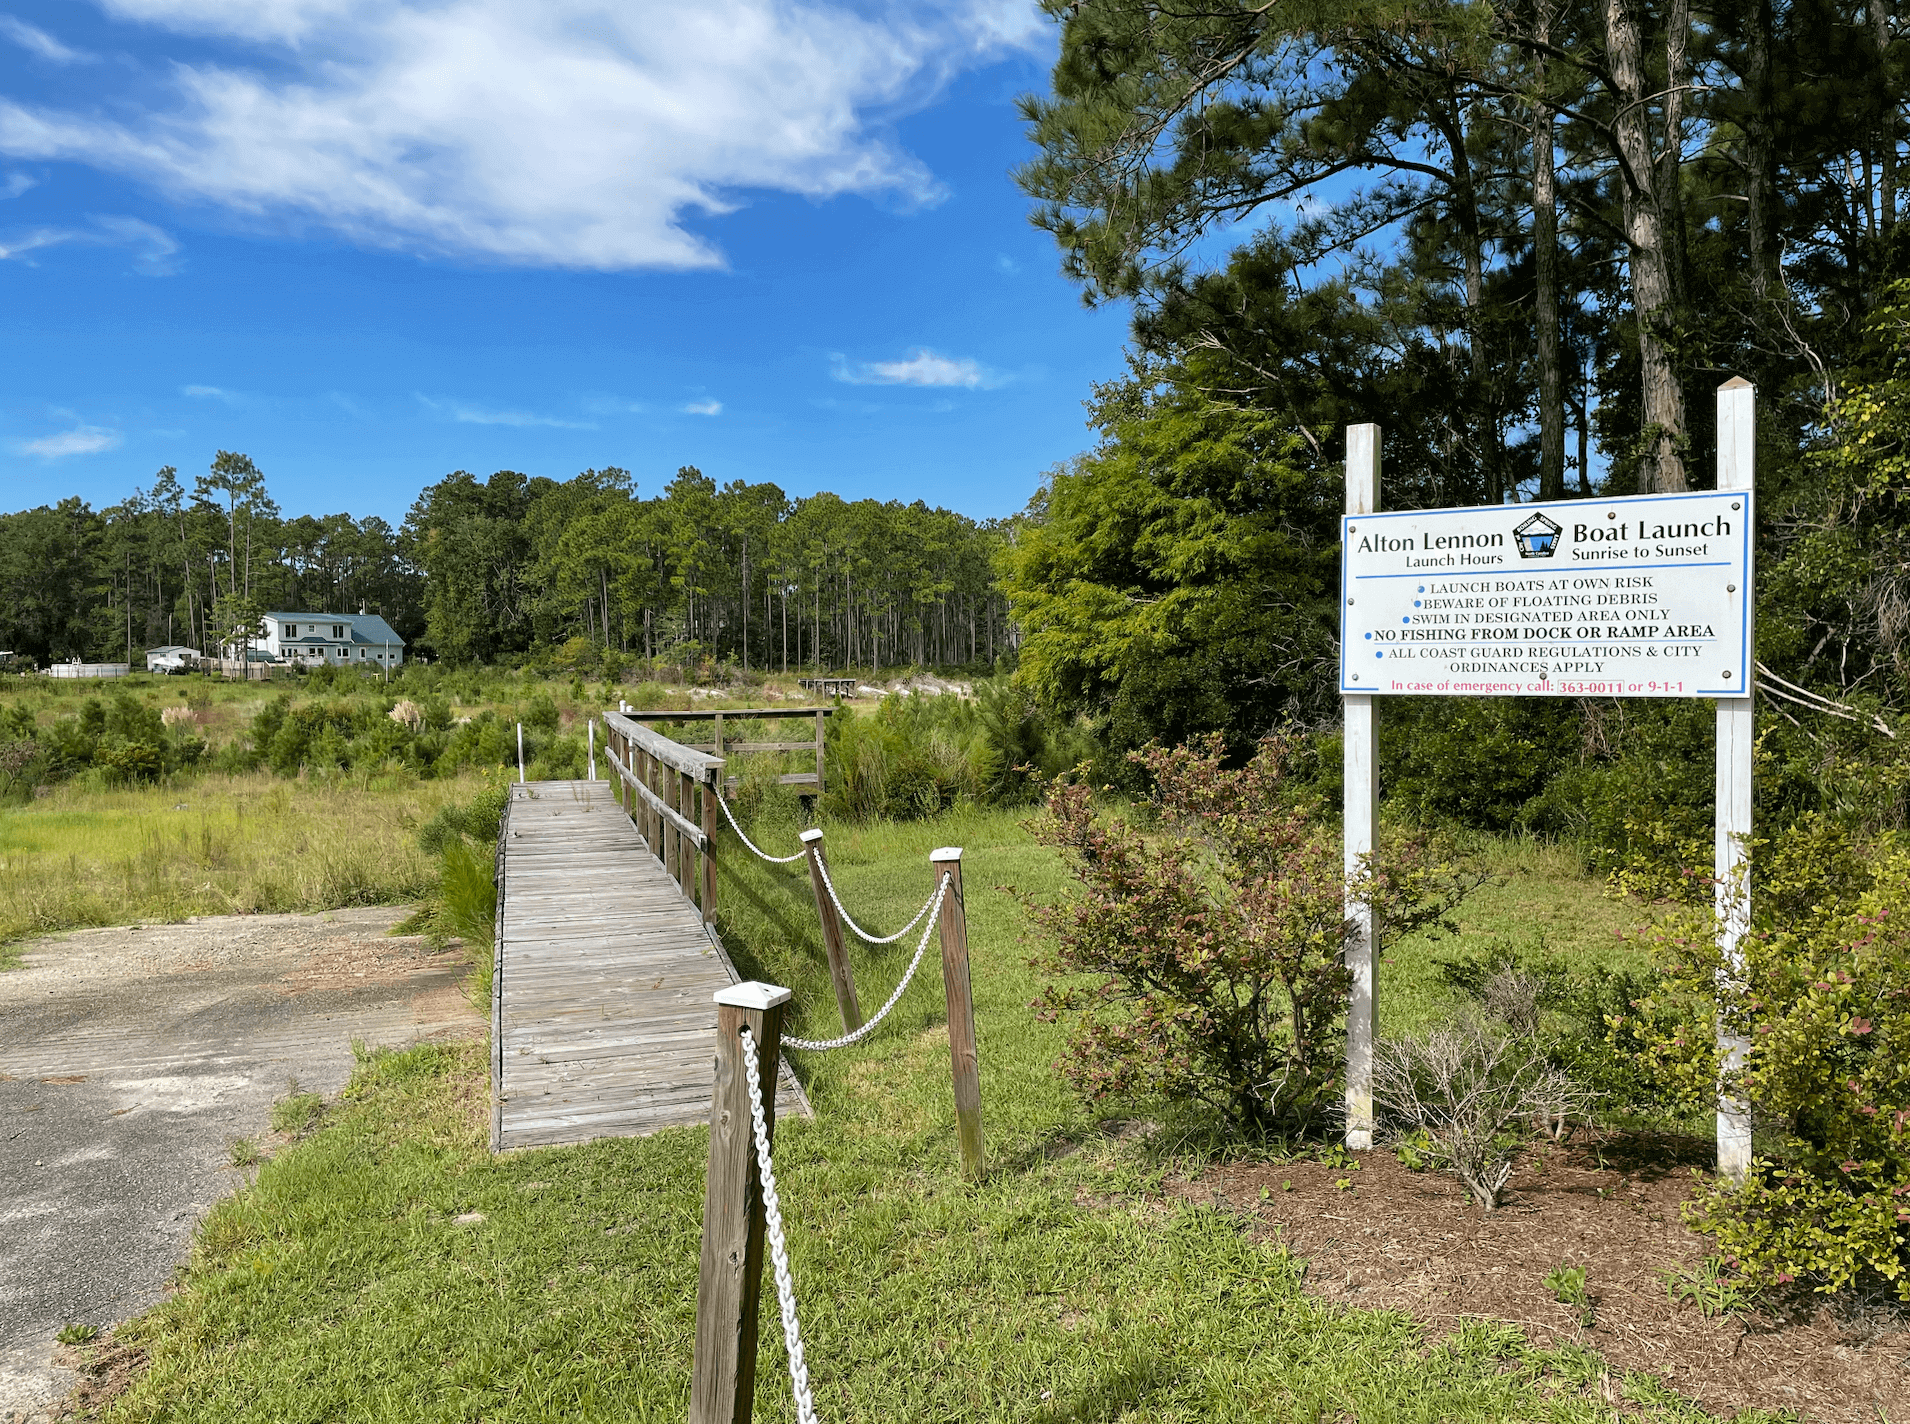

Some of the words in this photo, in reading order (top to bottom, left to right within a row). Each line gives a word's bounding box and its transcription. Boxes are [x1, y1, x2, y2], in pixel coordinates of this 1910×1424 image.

[1574, 523, 1628, 543] Boat
[1639, 515, 1731, 540] Launch
[1358, 534, 1414, 553] Alton
[1424, 532, 1503, 550] Lennon
[1572, 547, 1628, 560] Sunrise
[1634, 547, 1649, 558] to
[1655, 543, 1708, 557] Sunset
[1406, 555, 1455, 568] Launch
[1461, 553, 1503, 565] Hours
[1430, 582, 1490, 594] LAUNCH
[1495, 580, 1545, 592] BOATS
[1548, 579, 1569, 590] AT
[1573, 578, 1610, 589] OWN
[1615, 577, 1653, 588] RISK
[1423, 598, 1484, 609] BEWARE
[1489, 597, 1508, 607] OF
[1513, 594, 1591, 607] FLOATING
[1597, 593, 1657, 604] DEBRIS
[1412, 614, 1450, 624] SWIM
[1455, 614, 1470, 623] IN
[1475, 611, 1573, 623] DESIGNATED
[1577, 610, 1621, 622] AREA
[1625, 609, 1670, 621] ONLY
[1374, 630, 1396, 641] NO
[1400, 629, 1466, 641] FISHING
[1471, 628, 1518, 640] FROM
[1523, 627, 1572, 639] DOCK
[1577, 627, 1601, 638] OR
[1607, 626, 1659, 638] RAMP
[1663, 625, 1715, 637] AREA
[1389, 649, 1415, 658] ALL
[1420, 648, 1466, 658] COAST
[1471, 647, 1523, 658] GUARD
[1528, 646, 1641, 658] REGULATIONS
[1647, 647, 1658, 657] &
[1663, 646, 1702, 657] CITY
[1450, 662, 1548, 673] ORDINANCES
[1553, 662, 1605, 672] APPLY
[1391, 680, 1403, 690] In
[1407, 682, 1434, 691] case
[1437, 680, 1450, 690] of
[1454, 682, 1522, 693] emergency
[1527, 680, 1554, 691] call:
[1559, 682, 1623, 693] 363-0011
[1628, 682, 1643, 692] or
[1648, 682, 1683, 692] 9-1-1
